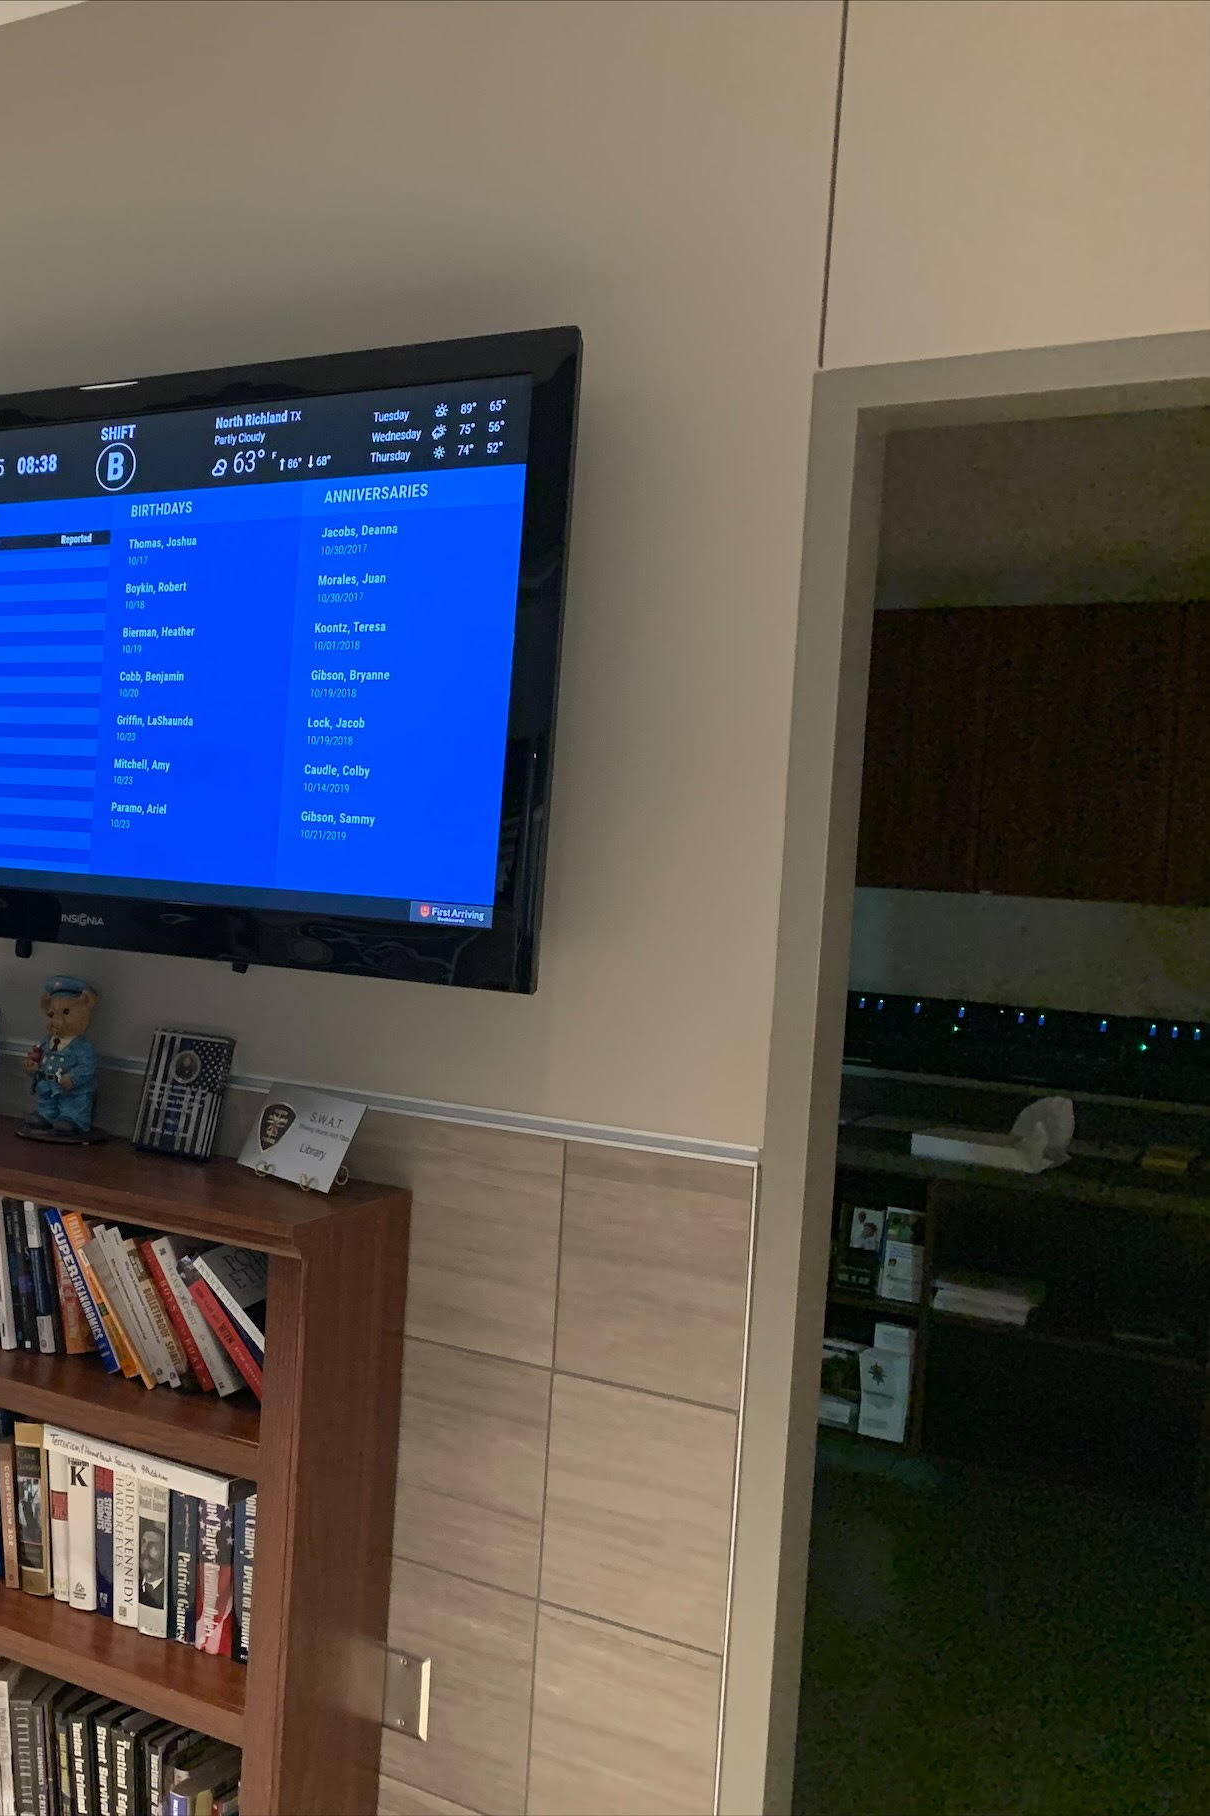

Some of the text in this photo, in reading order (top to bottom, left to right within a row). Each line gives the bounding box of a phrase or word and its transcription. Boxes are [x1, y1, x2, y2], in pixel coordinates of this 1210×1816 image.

[460, 402, 477, 415] 89°
[490, 399, 506, 412] 65°
[215, 411, 302, 430] North Richland TX
[374, 408, 410, 424] Tuesday
[100, 424, 136, 441] SHIFT
[459, 423, 476, 436] 75°
[488, 420, 505, 433] 56°
[214, 431, 266, 446] Partly Cloudy
[372, 427, 422, 444] Wednesday
[457, 443, 474, 457] 74°
[486, 441, 503, 454] 52°
[234, 448, 266, 474] 63°
[370, 449, 411, 464] Thursday
[17, 454, 58, 475] 08:38
[107, 452, 125, 482] B
[324, 484, 429, 505] ANNIVERSARIES
[130, 501, 193, 518] BIRTHDAYS
[321, 523, 398, 539] Jacobs, Deanna
[61, 533, 93, 547] Reported
[129, 535, 197, 550] Thomas, Joshua
[321, 543, 368, 556] 10/30/2017
[128, 555, 148, 566] 10/17
[126, 580, 187, 595] Boykin, Robert
[318, 572, 386, 588] Morales, Juan
[125, 599, 145, 610] 10/18
[317, 591, 364, 604] 10/30/2017
[122, 625, 195, 640] Bierman, Heather
[314, 620, 386, 636] Koontz, Teresa
[122, 644, 142, 654] 10/19
[314, 640, 361, 652] 10/01/2018
[120, 670, 184, 684] Cobb, Benjamin
[311, 669, 390, 683] Gibson, Bryanne
[118, 688, 139, 699] 10/20
[310, 687, 357, 699] 10/19/2018
[117, 715, 194, 728] Griffin, LaShaunda
[308, 717, 366, 731] Lock, Jacob
[116, 732, 136, 742] 10/23
[306, 735, 354, 747] 10/19/2018
[114, 759, 171, 773] Mitchell, Amy
[304, 764, 370, 779] Caudle, Colby
[113, 775, 133, 786] 10/23
[303, 782, 350, 794] 10/14/2019
[111, 803, 167, 816] Paramo, Ariel
[110, 819, 130, 829] 10/23
[301, 812, 376, 827] Gibson, Sammy
[300, 829, 347, 842] 10/21/2019
[61, 914, 104, 927] INSIGNIA
[432, 907, 485, 922] First Arriving
[299, 1144, 327, 1161] Library
[50, 1222, 104, 1341] SUPERFREAKONOMICS
[143, 1283, 170, 1338] BULLETPROOF
[70, 1467, 88, 1487] K
[5, 1465, 13, 1525] COURTROOM
[103, 1497, 113, 1534] STEPHEN
[116, 1523, 124, 1568] REEVES
[123, 1537, 134, 1607] KENNEDY
[176, 1552, 191, 1641] Patriot Games
[72, 1722, 88, 1814] Tactics for Criminal
[96, 1726, 110, 1816] Street Survival
[116, 1740, 128, 1790] Tactical
